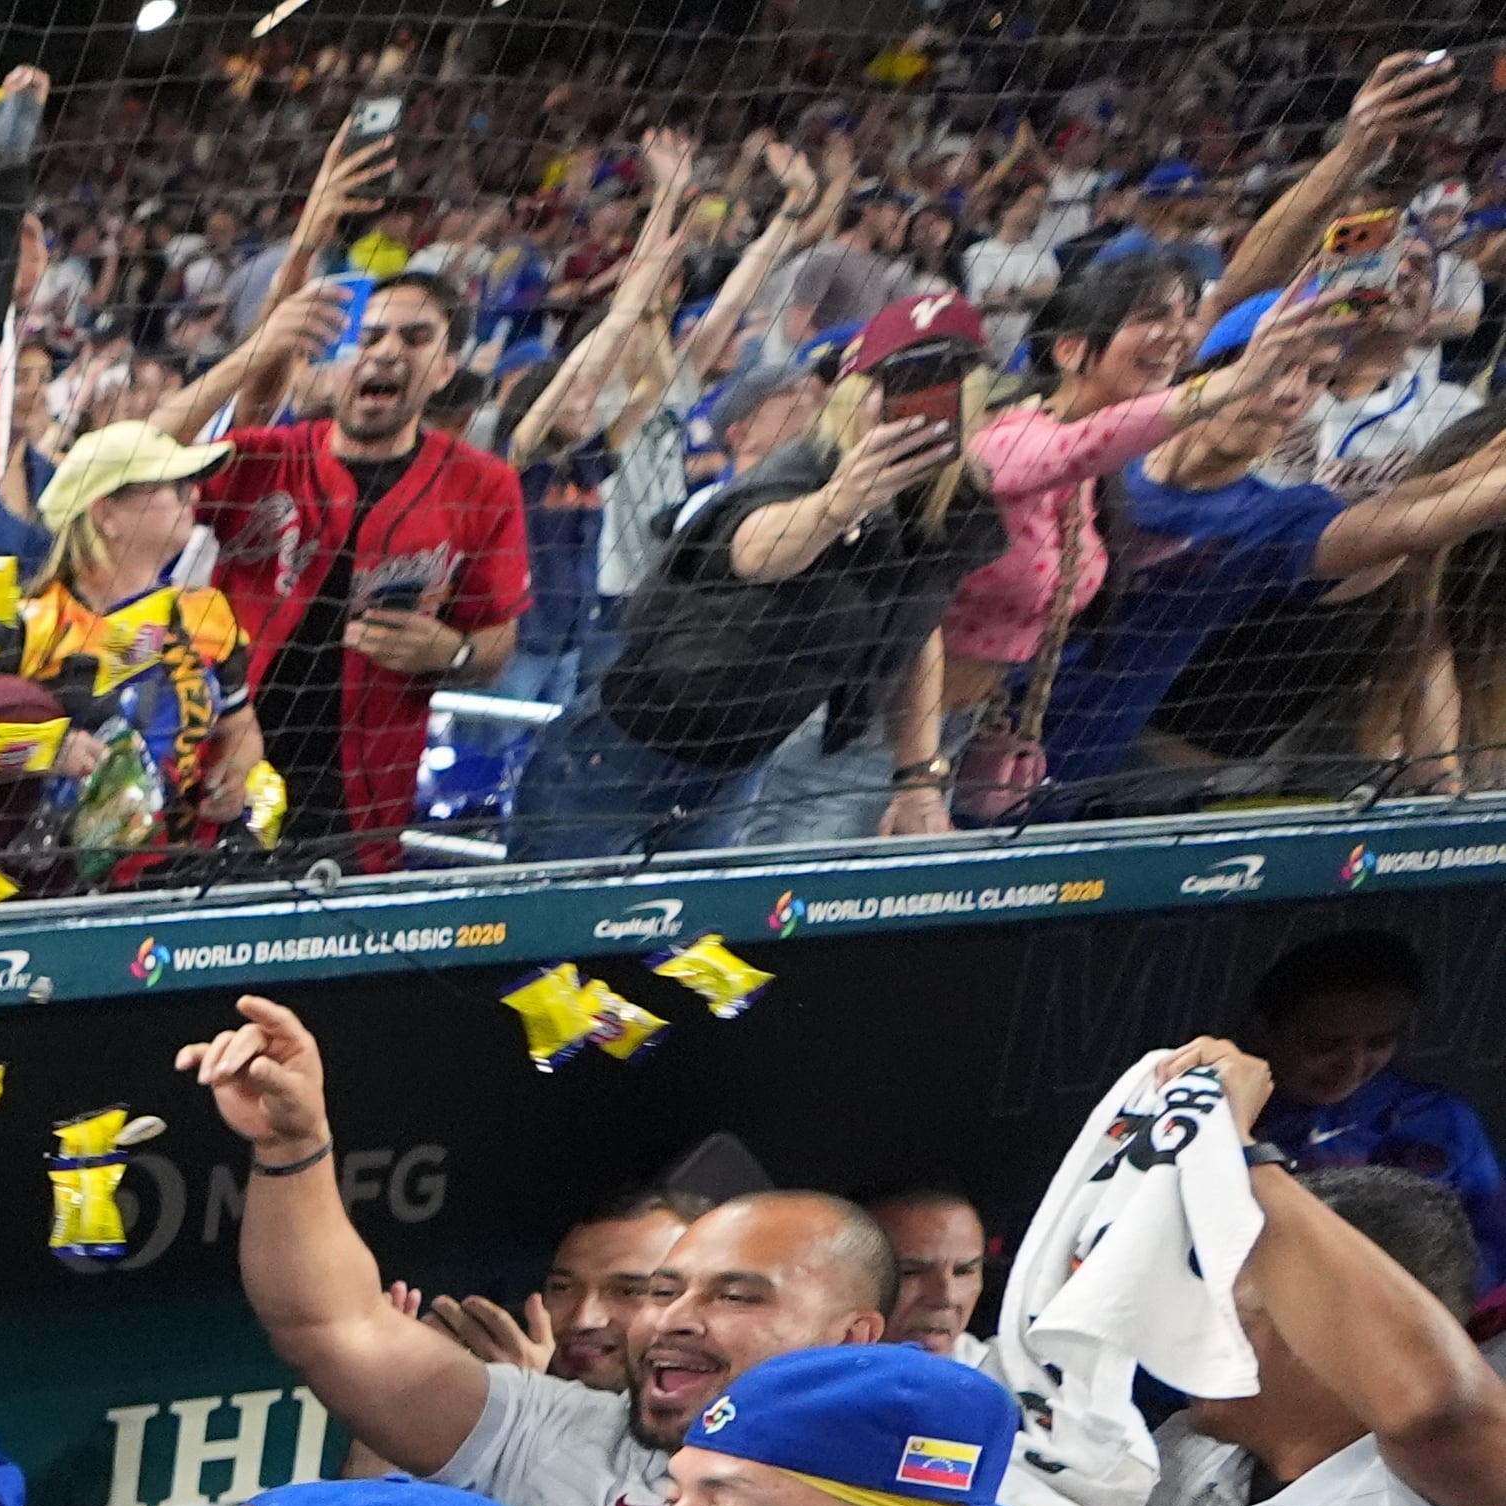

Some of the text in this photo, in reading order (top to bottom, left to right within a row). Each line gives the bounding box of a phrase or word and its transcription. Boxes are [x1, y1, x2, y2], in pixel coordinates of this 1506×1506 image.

[1376, 850, 1438, 874] WORLD
[806, 898, 877, 924] WORLD
[879, 890, 977, 918] BASEBALL
[977, 882, 1059, 911] CLASSIC
[173, 922, 507, 970] WORLD BASEBALL CLASSIC 2026
